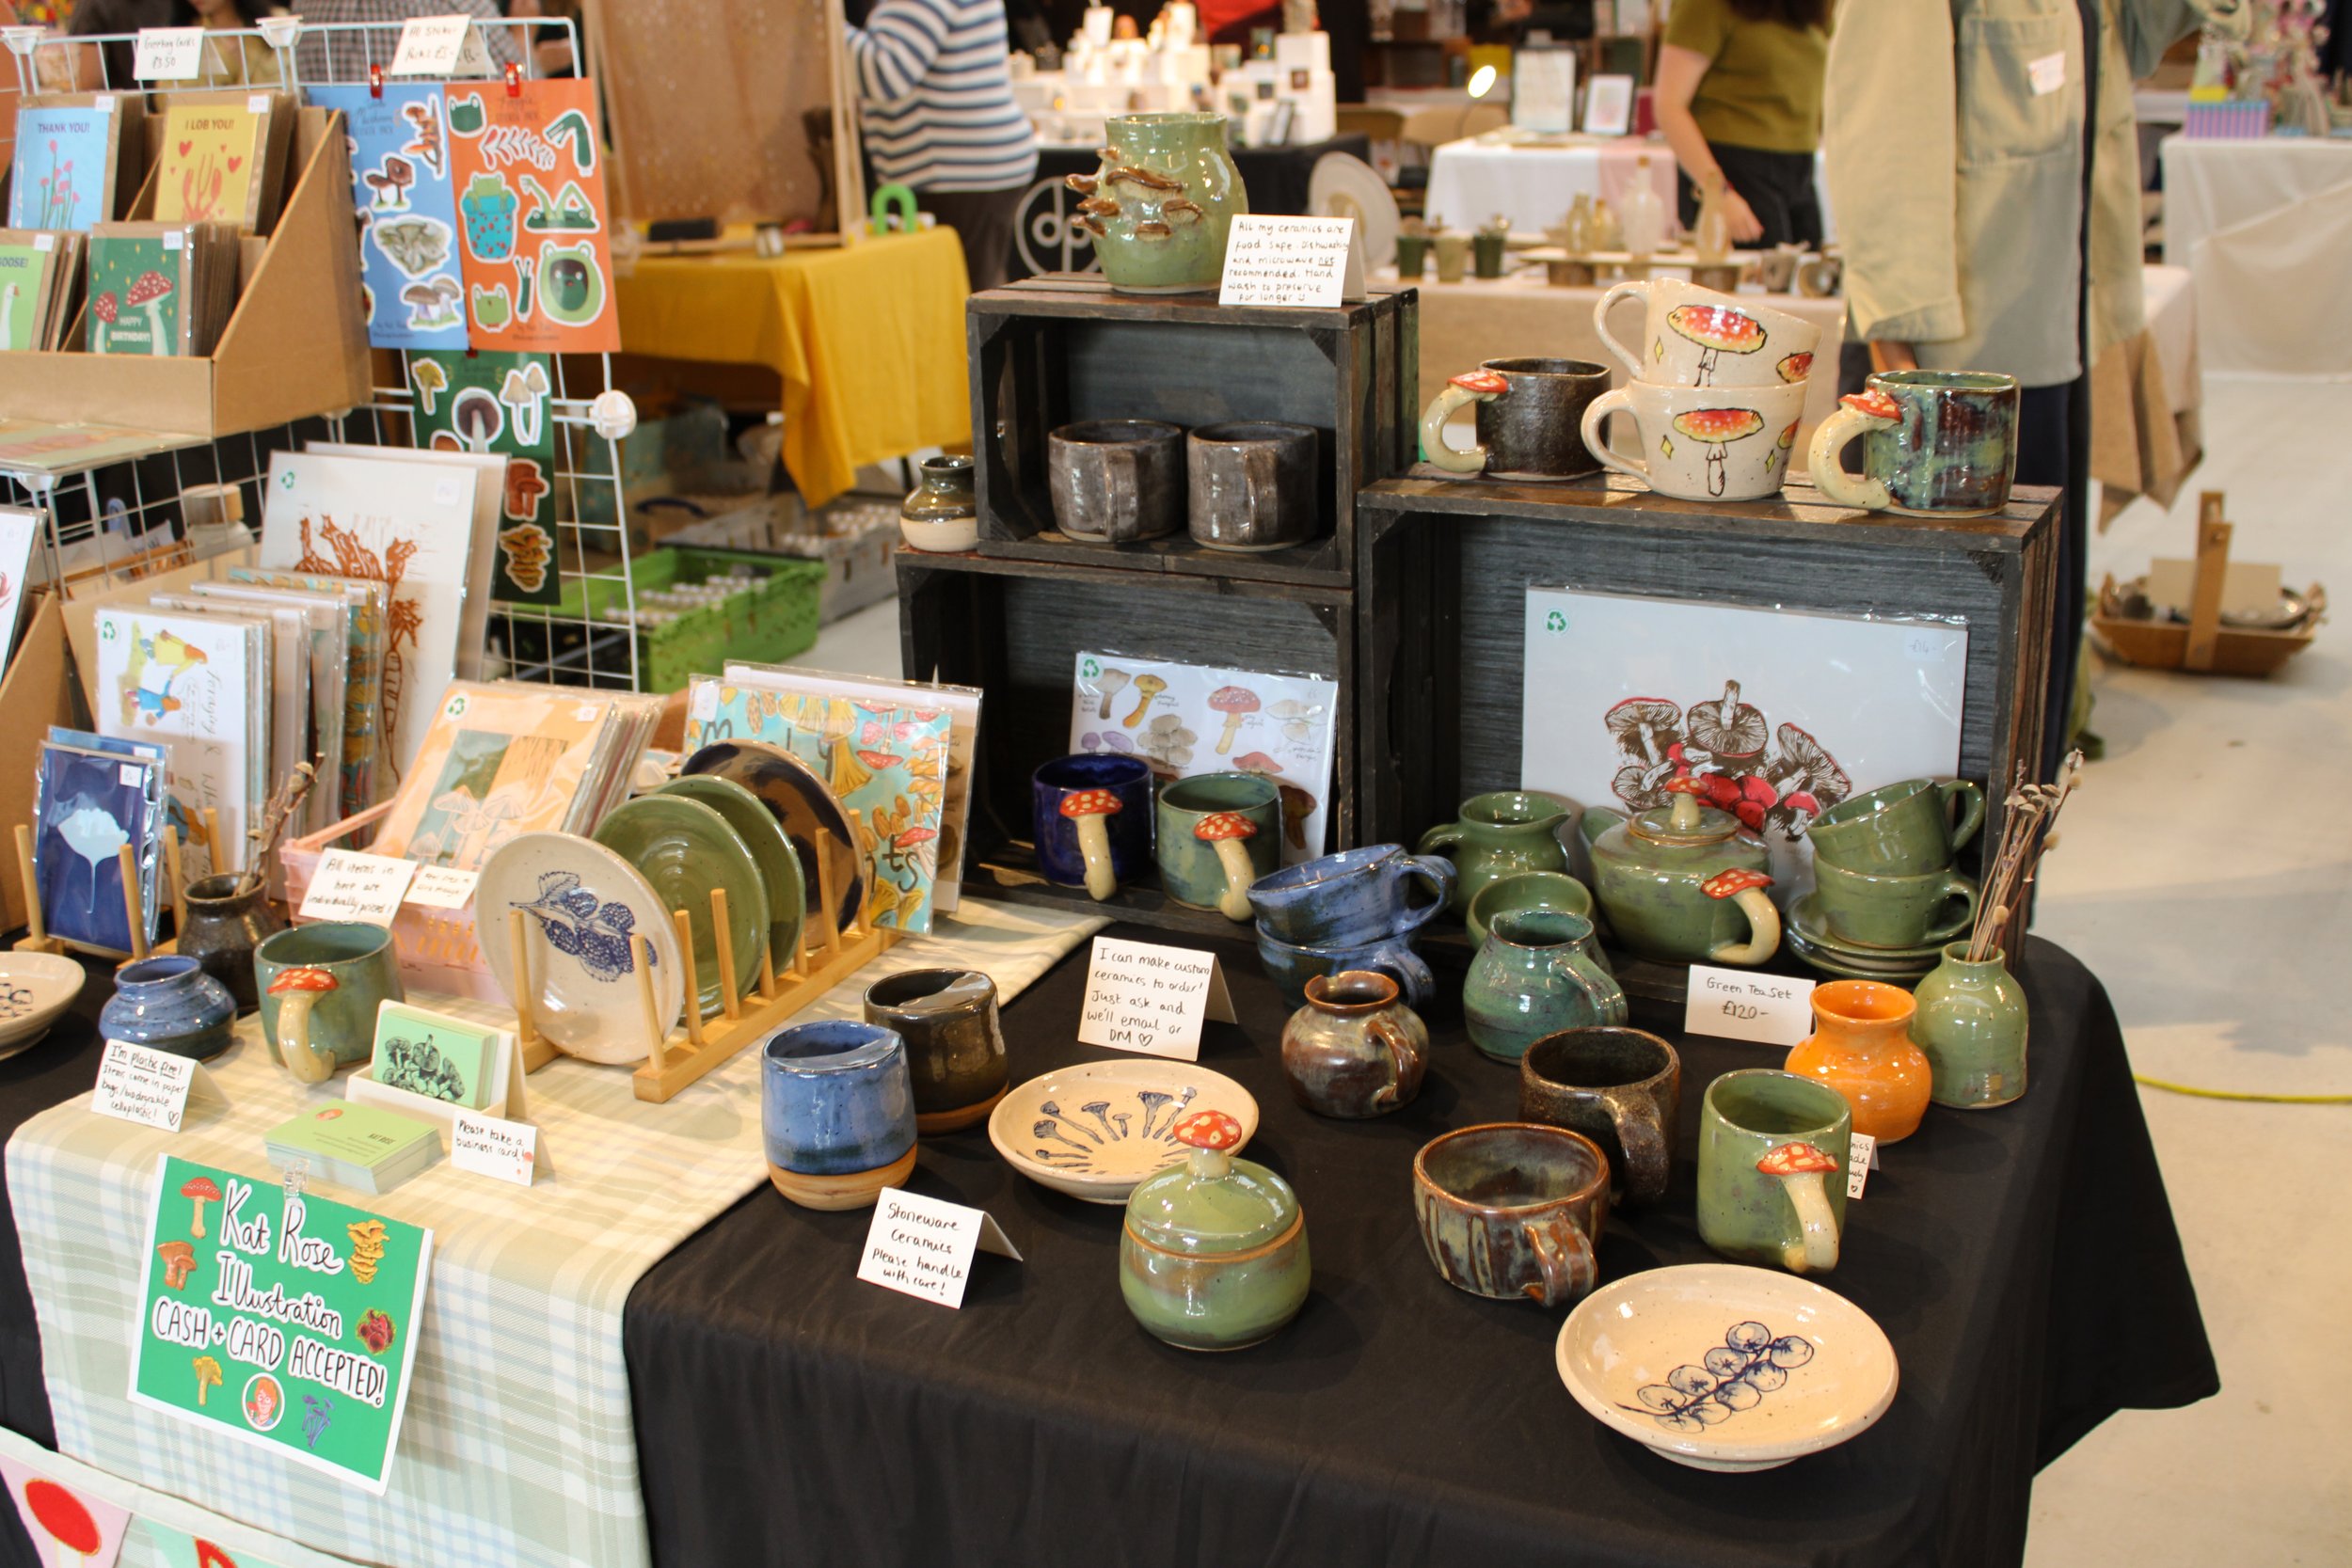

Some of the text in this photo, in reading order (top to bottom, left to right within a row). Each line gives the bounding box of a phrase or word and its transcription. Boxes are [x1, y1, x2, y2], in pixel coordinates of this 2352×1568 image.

[39, 122, 90, 134] THANK YOU!
[190, 119, 209, 130] LOB
[212, 119, 234, 130] YOU!
[1238, 221, 1253, 232] All
[1259, 224, 1273, 235] my
[1279, 223, 1321, 233] ceramics
[1235, 239, 1261, 252] food
[1232, 256, 1335, 265] and microwave not
[1306, 269, 1333, 277] Hand
[1229, 282, 1322, 293] wash to preserve
[1239, 293, 1293, 304] for longer
[119, 316, 143, 326] HAPPY
[326, 858, 394, 875] All items in
[334, 880, 380, 892] here are
[307, 893, 358, 914] individually
[1099, 947, 1211, 975] I can make custom
[1094, 970, 1203, 995] ceramics to order!
[1707, 976, 1792, 1000] Green Tea Set
[1091, 990, 1185, 1015] Just ask and
[1087, 1007, 1183, 1035] we'll email or
[1109, 1028, 1132, 1044] DM
[111, 1044, 128, 1059] I'm
[131, 1051, 159, 1069] plastic
[129, 1071, 149, 1085] come
[151, 1077, 160, 1088] in
[162, 1083, 186, 1096] paper
[458, 1119, 524, 1147] Please take a
[455, 1135, 493, 1153] business
[887, 1202, 961, 1231] Stoneware
[222, 1183, 343, 1271] Kat Rose
[882, 1268, 909, 1284] with
[916, 1256, 963, 1279] handle
[215, 1254, 342, 1338] Illustration
[155, 1299, 209, 1345] CASH
[229, 1318, 283, 1367] CARD
[291, 1338, 387, 1406] ACCEPTED!
